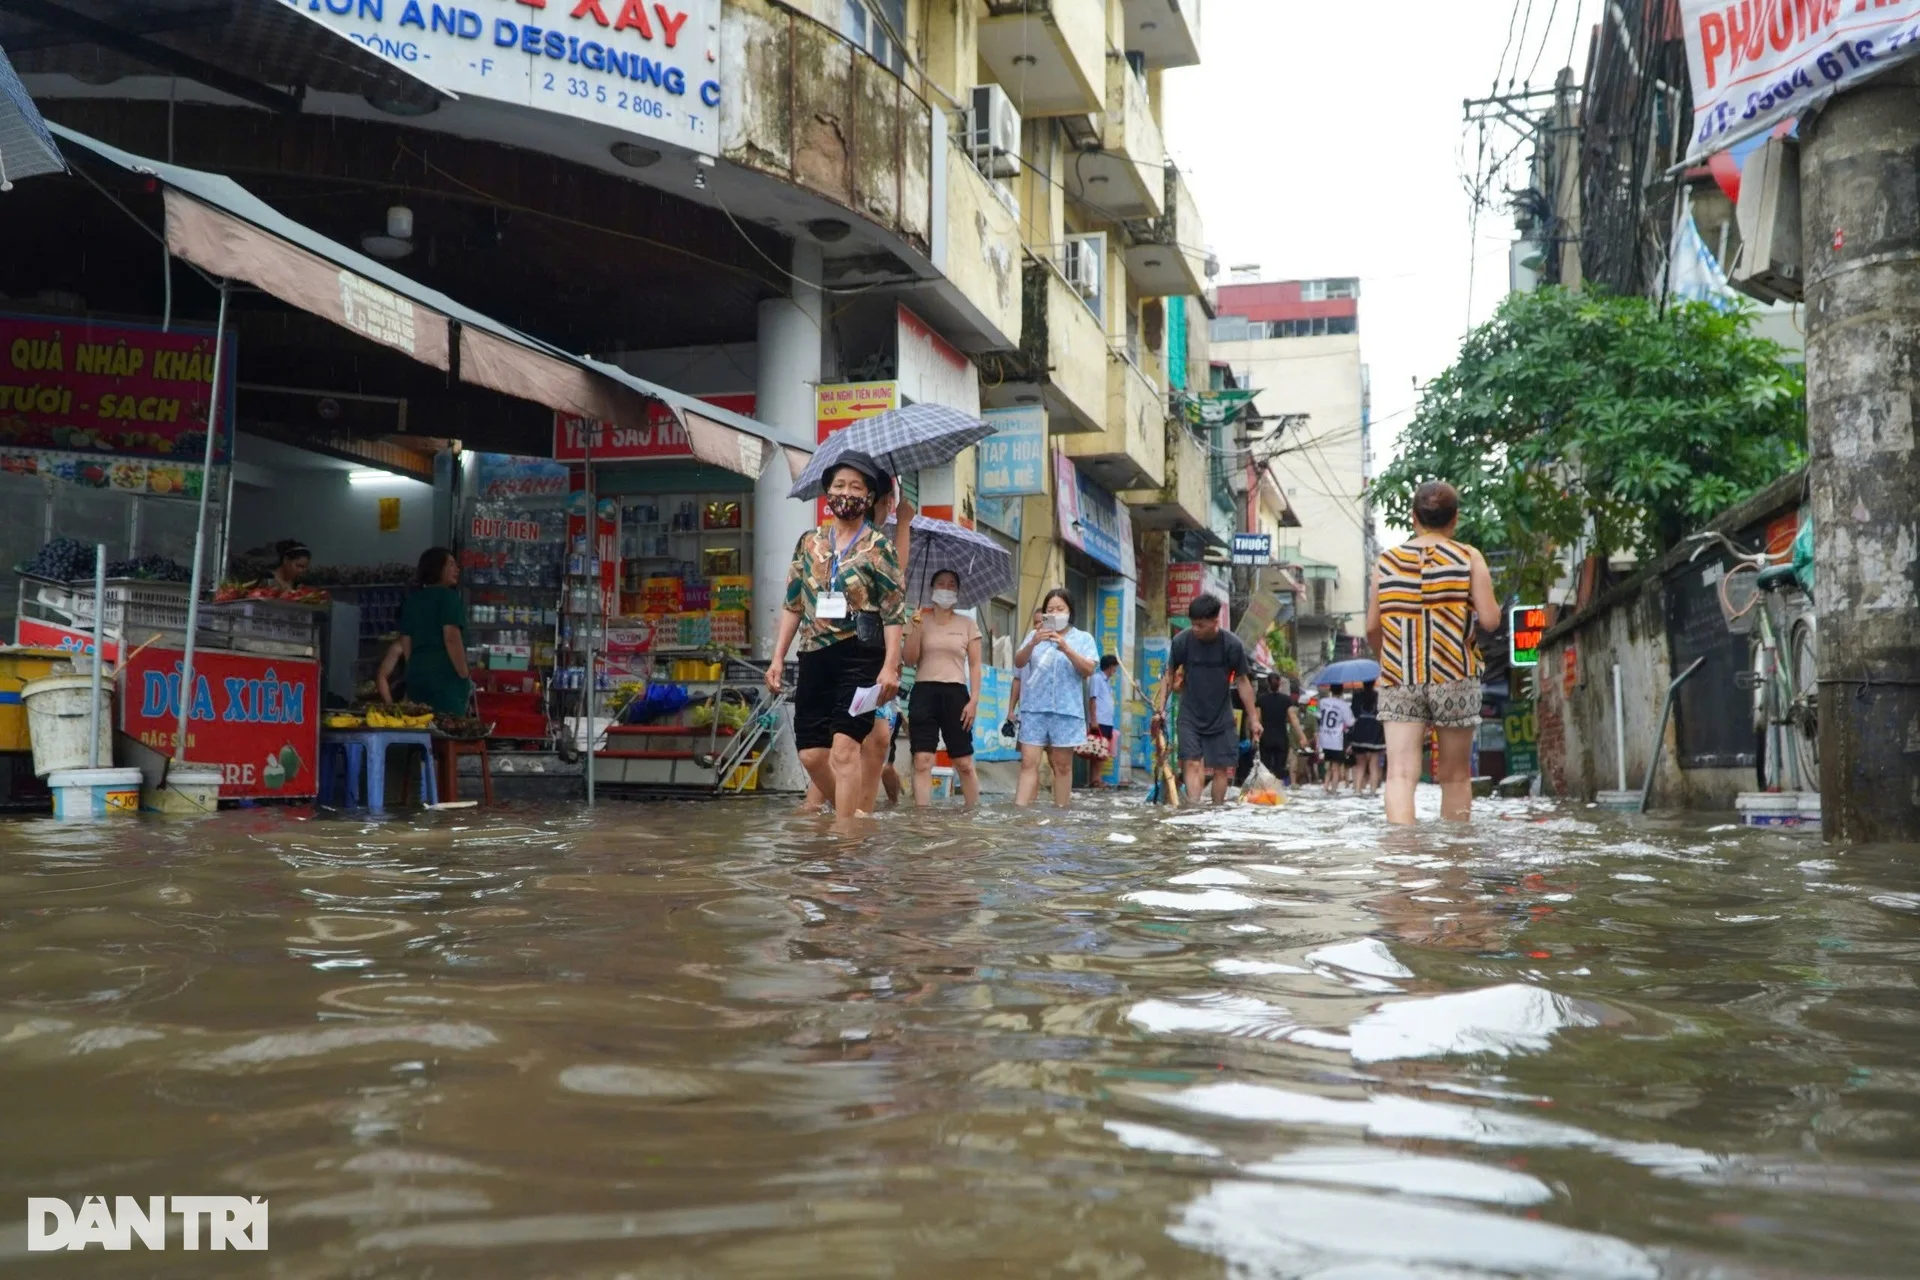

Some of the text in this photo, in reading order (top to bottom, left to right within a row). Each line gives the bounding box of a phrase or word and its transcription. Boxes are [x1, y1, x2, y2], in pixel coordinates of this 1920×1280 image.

[399, 0, 484, 40] AND
[494, 18, 685, 96] DESIGNING
[11, 331, 64, 372] QUẢ
[75, 339, 144, 385] NHẬP
[98, 393, 181, 426] SẠCH
[658, 415, 690, 447] KH
[141, 660, 306, 725] DỪA XIÊM
[170, 733, 195, 749] SN
